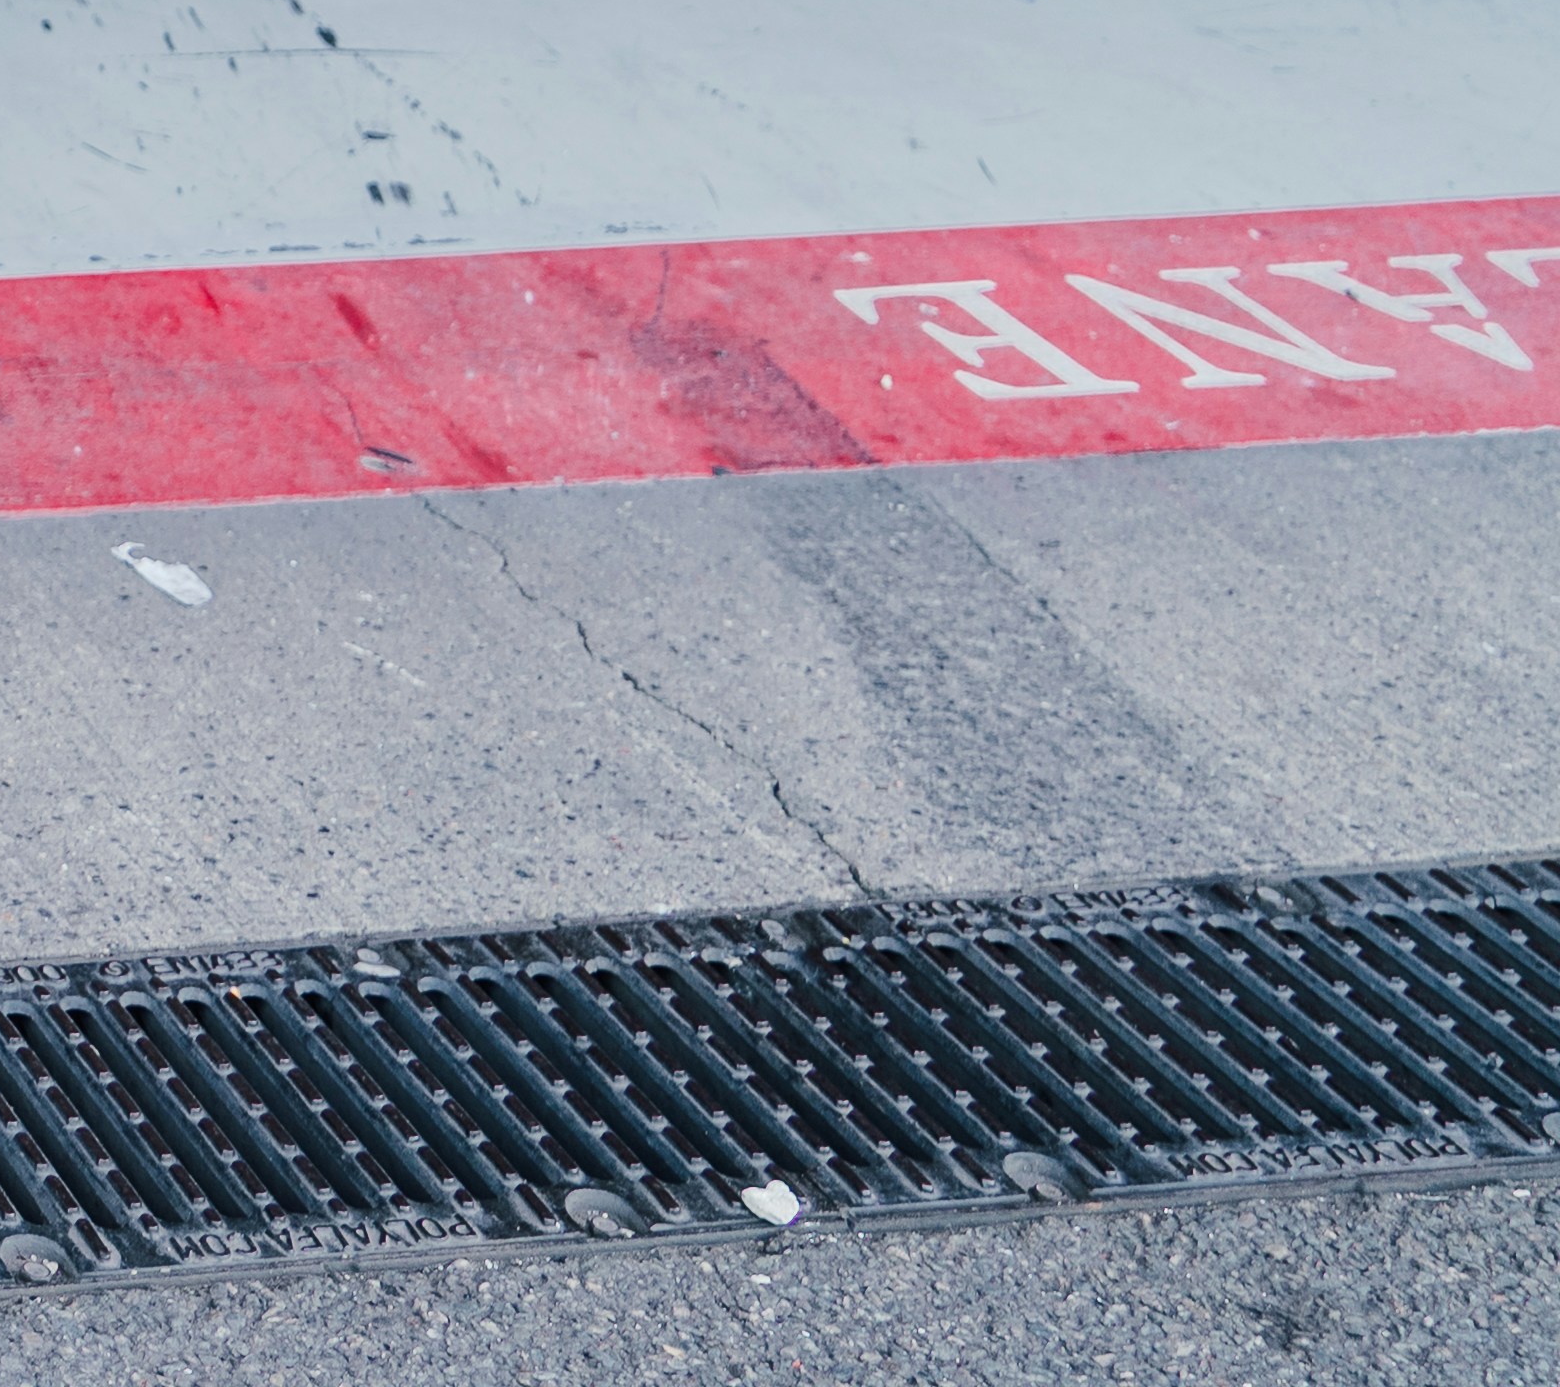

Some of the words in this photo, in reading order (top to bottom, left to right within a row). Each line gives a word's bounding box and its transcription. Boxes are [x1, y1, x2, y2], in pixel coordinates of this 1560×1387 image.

[875, 898, 984, 924] F900
[141, 949, 284, 976] EN1433
[1165, 1135, 1468, 1178] POLYALFA.COM
[169, 1214, 480, 1263] POLYALFA.COM
